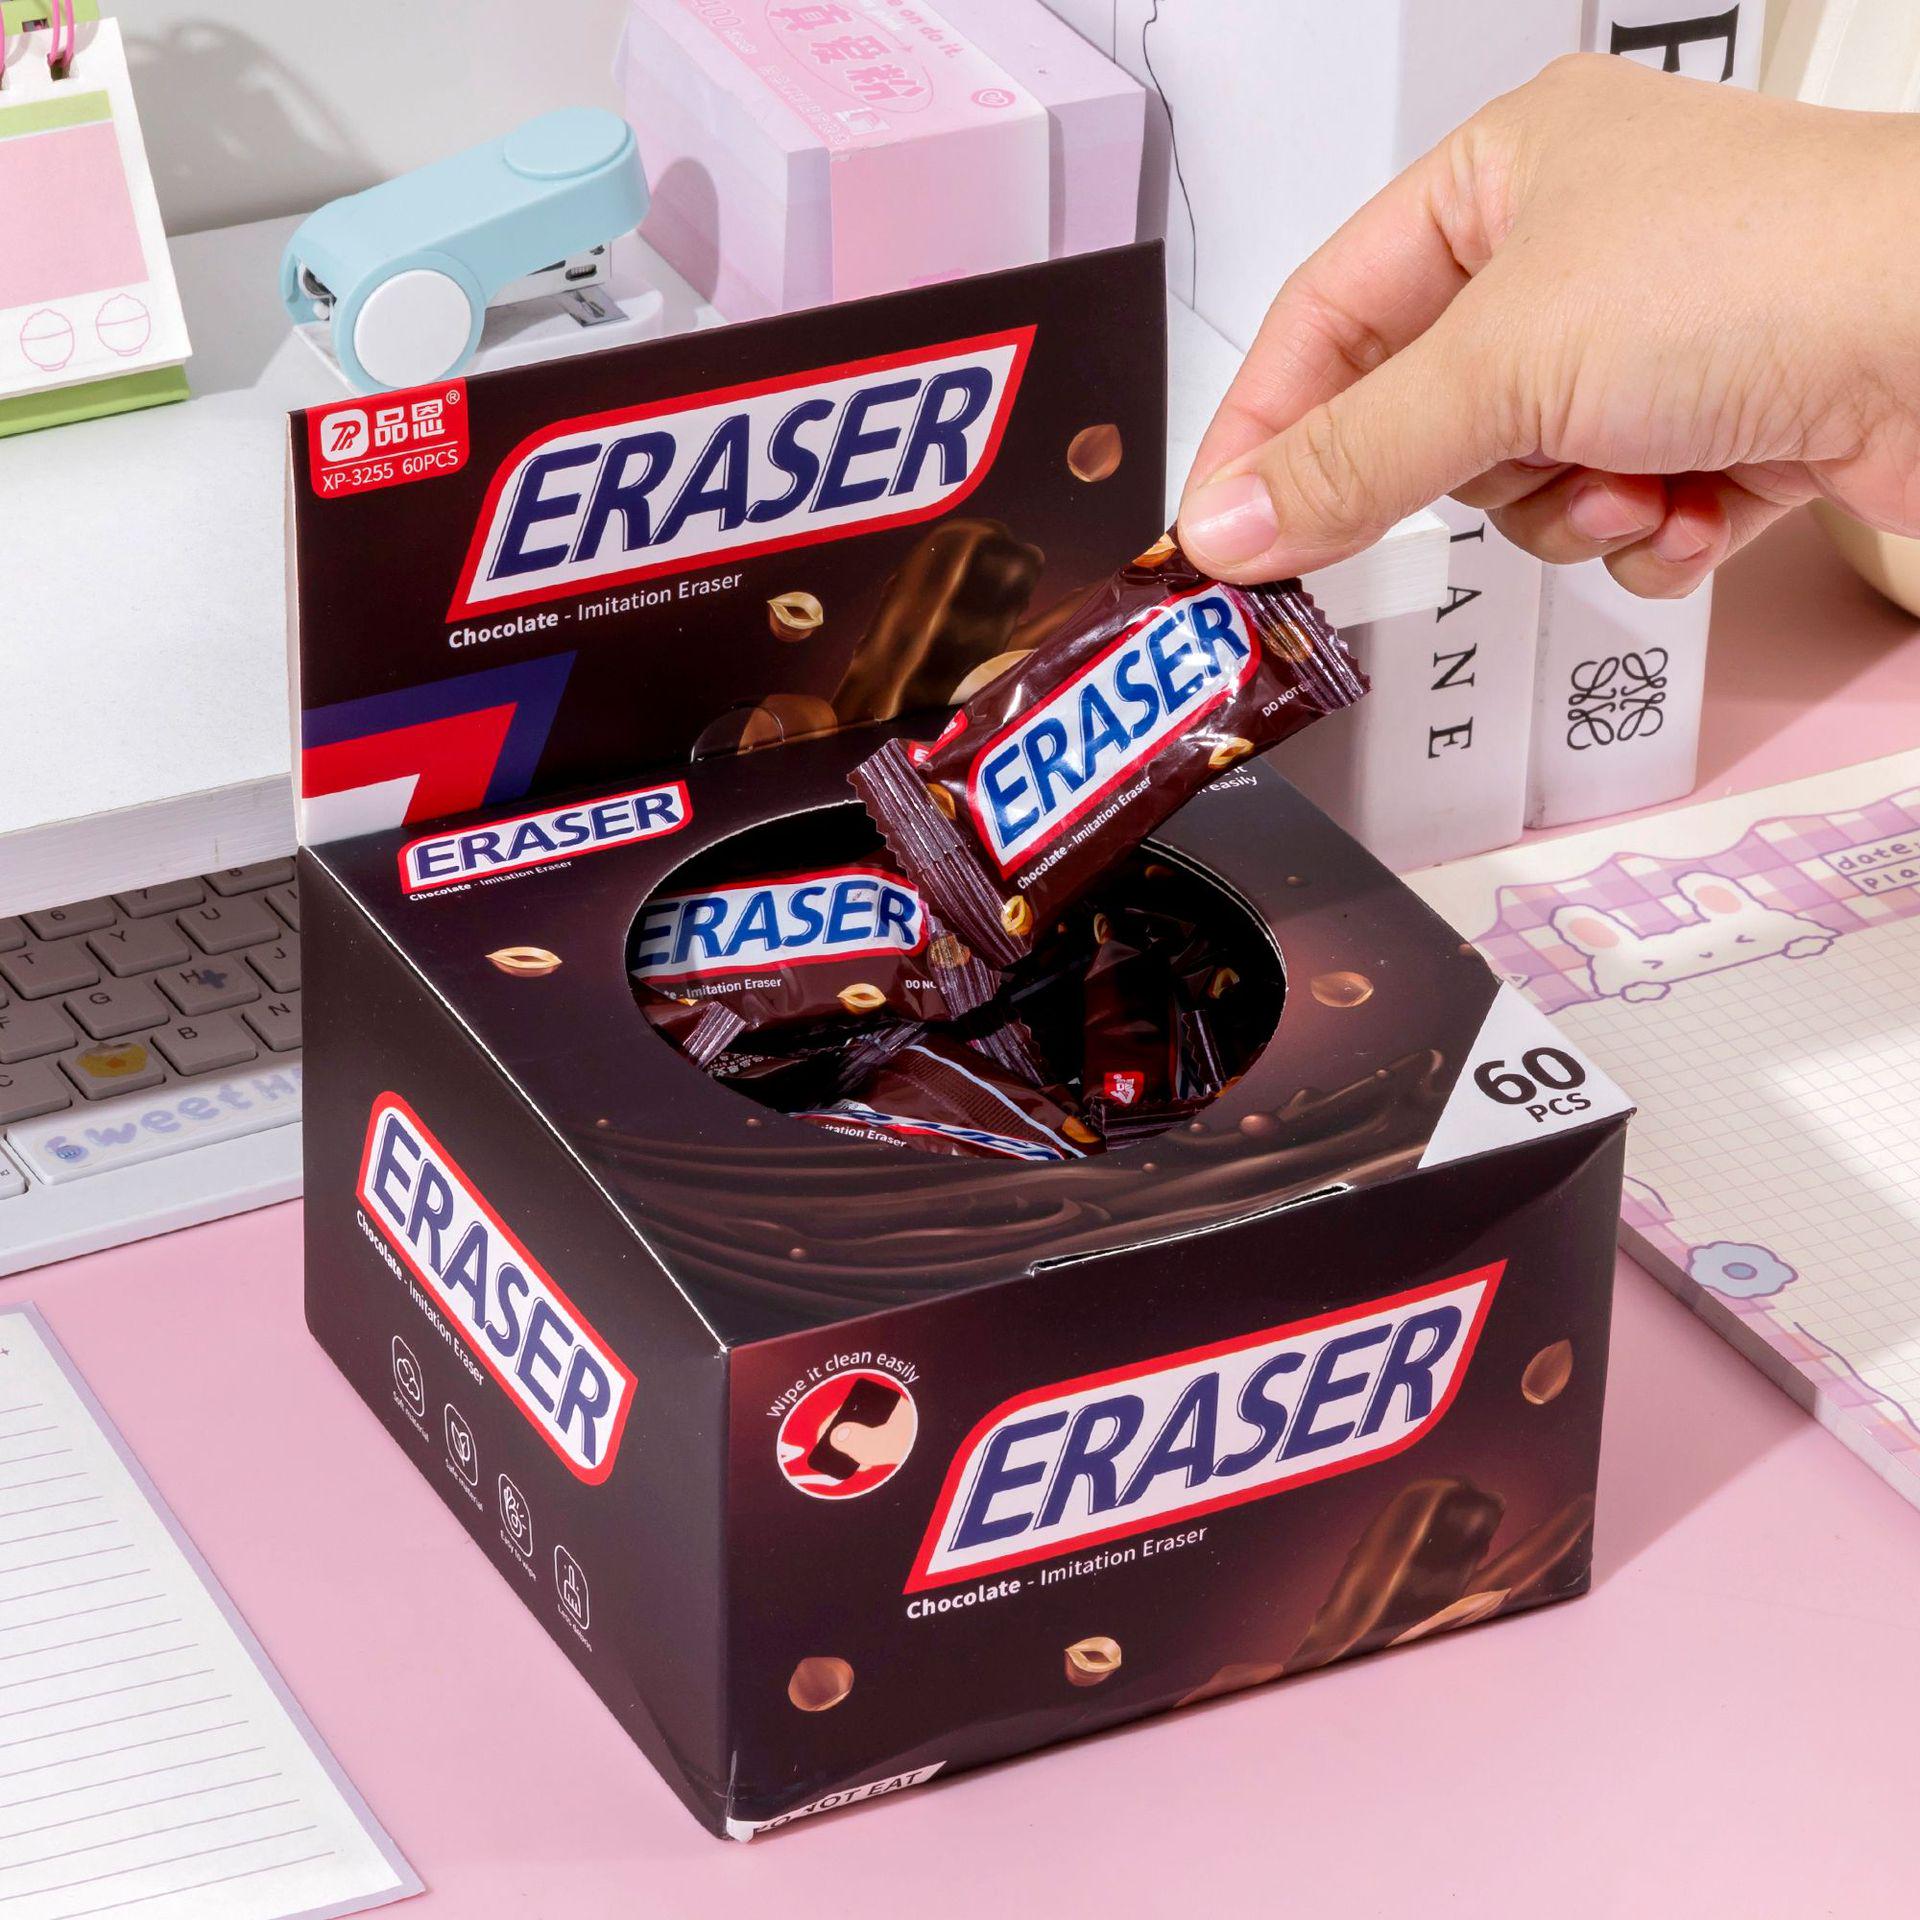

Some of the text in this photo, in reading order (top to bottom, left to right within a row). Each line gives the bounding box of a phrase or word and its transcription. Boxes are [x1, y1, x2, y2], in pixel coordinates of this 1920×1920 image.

[323, 449, 460, 492] XP-3255 60PCS
[487, 366, 993, 581] ERASER
[448, 609, 559, 649] Chocolate
[577, 584, 672, 622] Imitation
[678, 571, 743, 601] Eraser
[1262, 701, 1279, 717] DO
[1278, 687, 1299, 705] NOT
[982, 596, 1249, 849] ERASER
[1209, 776, 1258, 791] easily
[414, 792, 680, 881] ERASER
[1017, 844, 1068, 890] Chocolate
[1072, 804, 1121, 846] Imitation
[1118, 774, 1154, 810] Eraser
[409, 882, 472, 902] Chocolate
[480, 868, 535, 887] Imitation
[536, 859, 573, 874] Eraser
[50, 910, 67, 921] 6
[200, 908, 221, 921] U
[109, 930, 127, 942] Y
[17, 952, 35, 965] T
[273, 947, 287, 960] J
[180, 969, 201, 984] H
[686, 980, 743, 998] Imitation
[744, 976, 783, 990] Eraser
[905, 979, 921, 990] DO
[89, 992, 111, 1005] G
[268, 1002, 292, 1016] N
[177, 1026, 199, 1041] B
[1474, 1047, 1586, 1105] 60
[1525, 1092, 1592, 1123] PCS
[866, 1129, 907, 1148] Eraser
[357, 1210, 403, 1281] Chocolate
[408, 1279, 452, 1348] Imitation
[453, 1340, 485, 1387] Eraser
[373, 1113, 611, 1466] ERASER
[766, 1351, 920, 1418] Wipe it clean easily
[948, 1304, 1463, 1552] ERASER
[906, 1575, 1022, 1620] Chocolate
[1040, 1547, 1137, 1587] Imitation
[1142, 1526, 1208, 1557] Eraser
[867, 1771, 923, 1796] EAT
